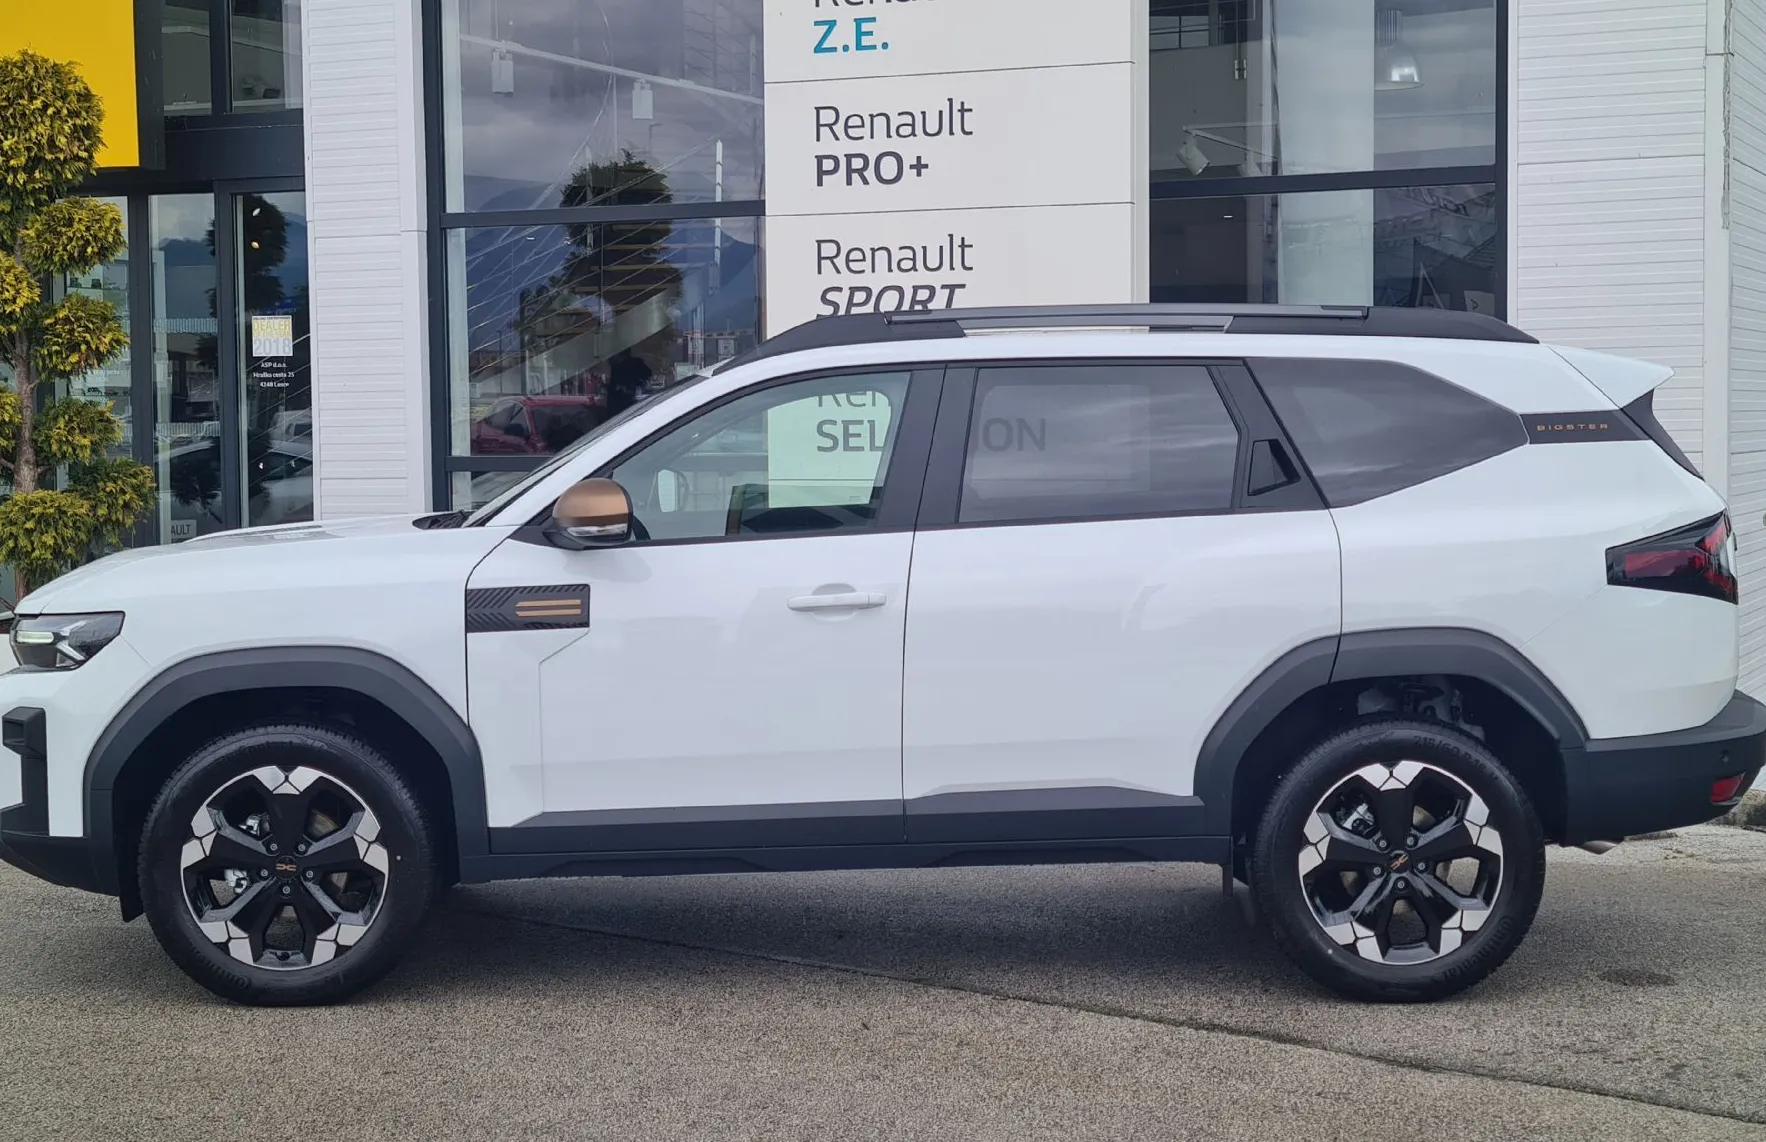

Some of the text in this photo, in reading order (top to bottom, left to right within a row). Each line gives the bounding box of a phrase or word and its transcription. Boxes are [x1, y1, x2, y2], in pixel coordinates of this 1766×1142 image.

[813, 17, 889, 54] Z.E.
[814, 98, 973, 142] Renault
[815, 151, 929, 187] PRO+
[815, 234, 973, 275] Renault
[819, 284, 966, 316] SPORT
[253, 320, 290, 331] DEALER
[254, 338, 291, 355] 2018
[1537, 423, 1608, 432] BIGSTER
[171, 524, 192, 536] AULT
